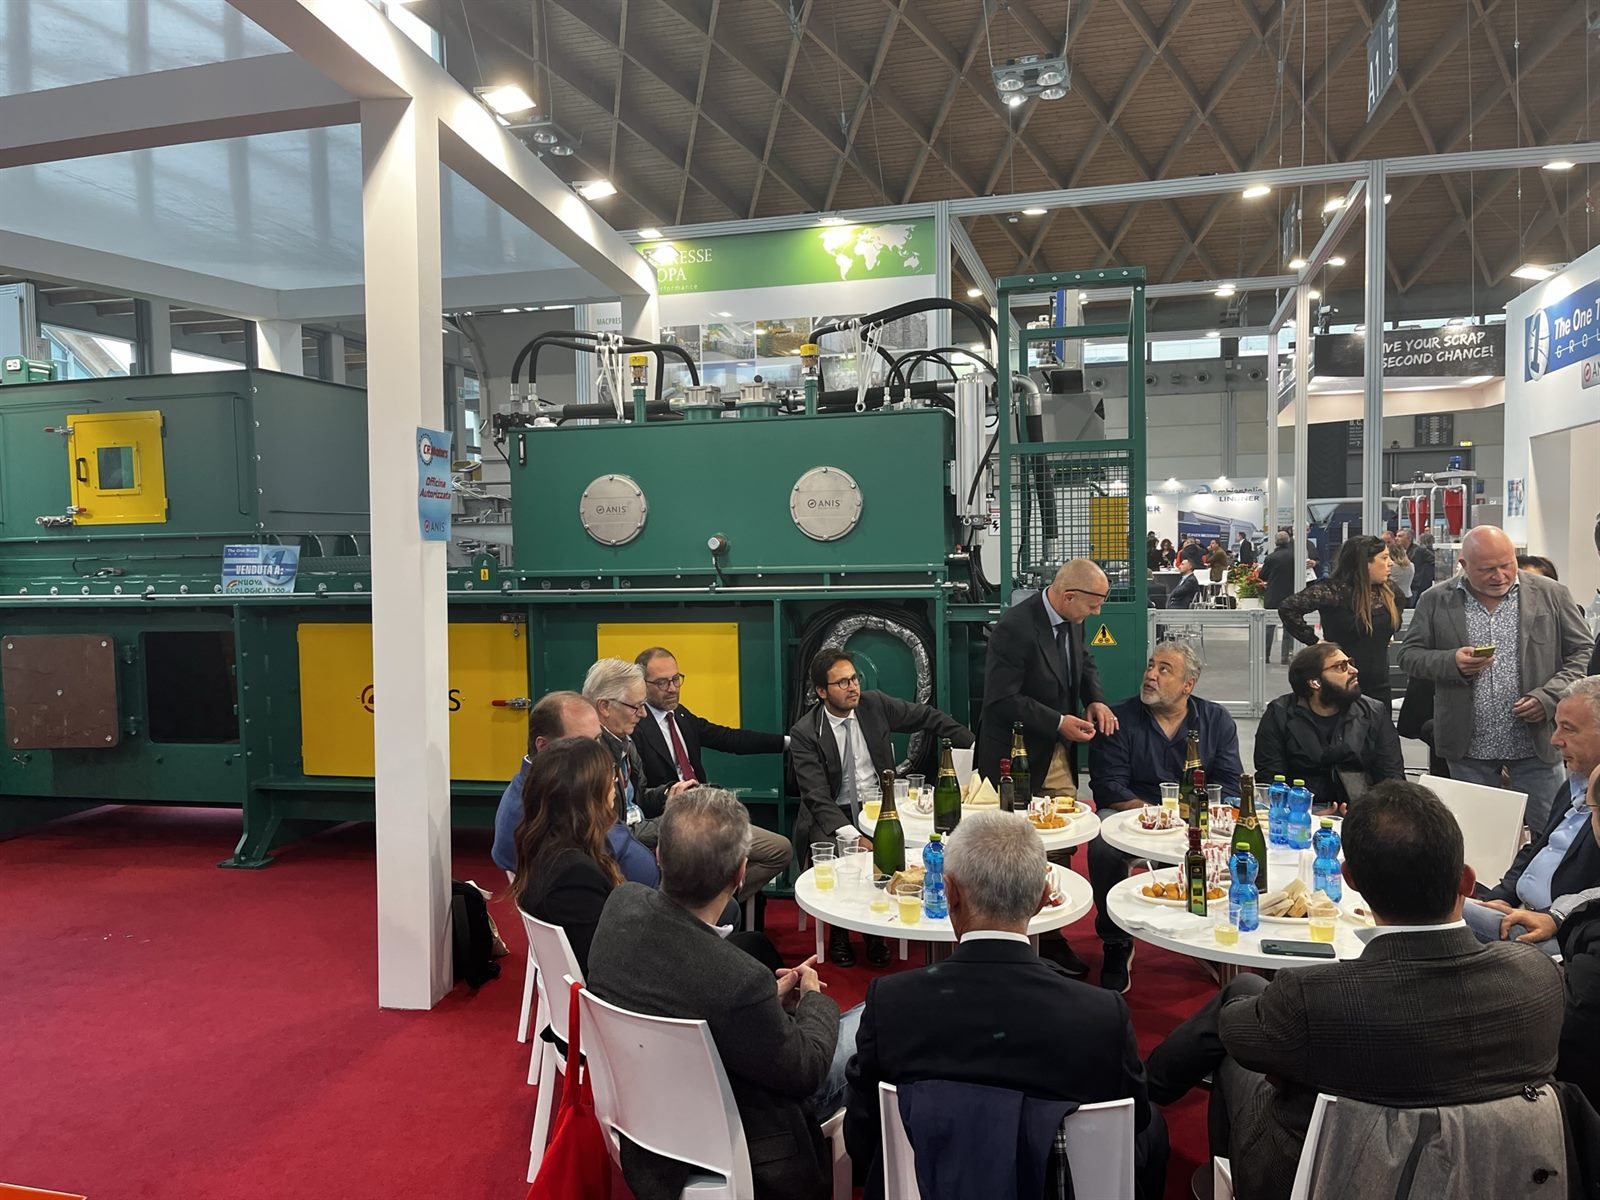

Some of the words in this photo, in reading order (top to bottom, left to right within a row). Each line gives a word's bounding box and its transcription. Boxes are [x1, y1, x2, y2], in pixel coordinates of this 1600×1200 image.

[1554, 317, 1571, 340] The
[1573, 308, 1592, 332] One
[1405, 336, 1441, 352] YOUR
[1443, 331, 1486, 347] SCRAP
[1382, 352, 1433, 369] SECOND
[1436, 345, 1495, 362] CHANCE!
[605, 505, 627, 513] ANIS
[818, 499, 841, 507] ANIS
[431, 521, 446, 533] ANIS
[235, 565, 273, 575] VENDUTA
[274, 565, 284, 575] A:
